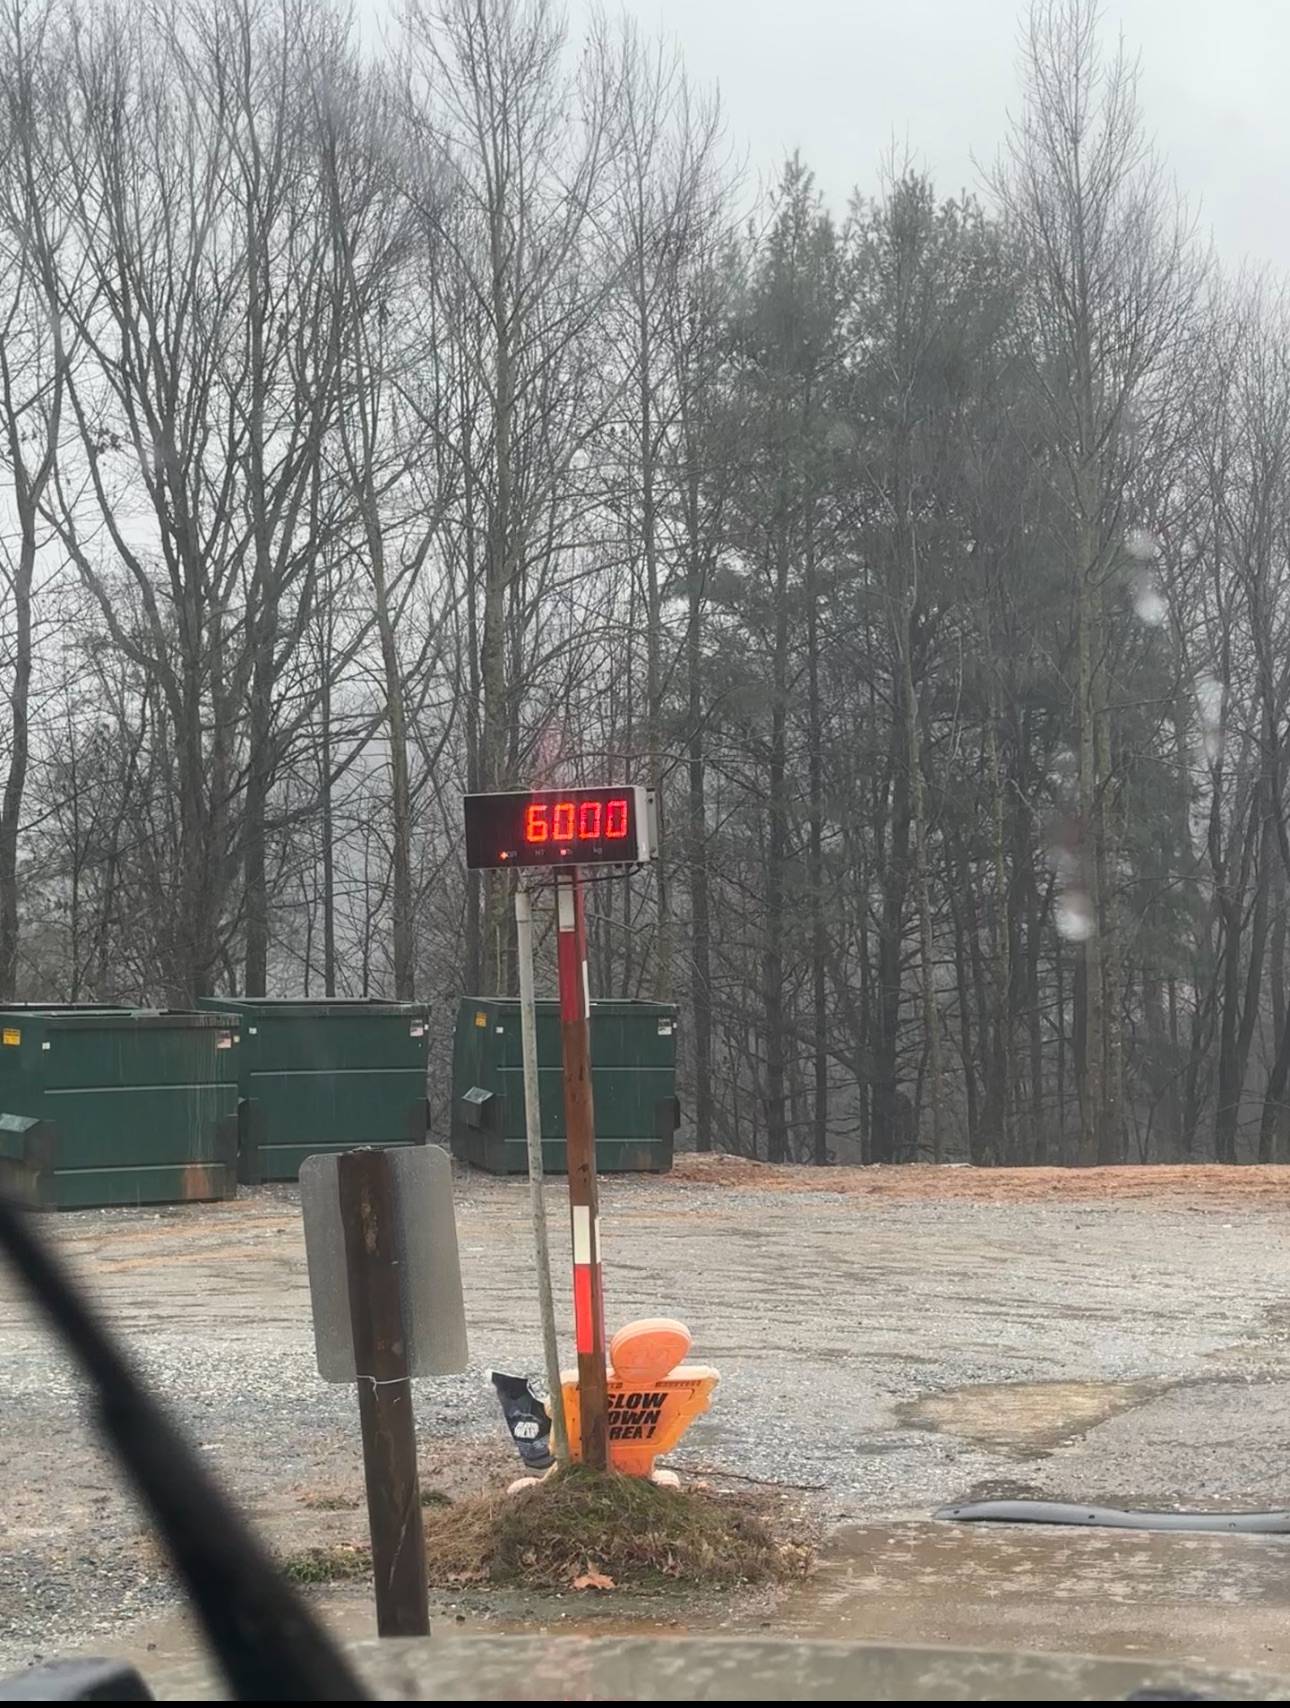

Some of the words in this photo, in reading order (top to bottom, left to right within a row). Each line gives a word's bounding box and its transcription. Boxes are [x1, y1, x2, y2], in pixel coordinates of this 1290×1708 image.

[526, 800, 628, 842] 6000
[607, 1409, 662, 1425] OWN
[609, 1426, 656, 1440] REA!
